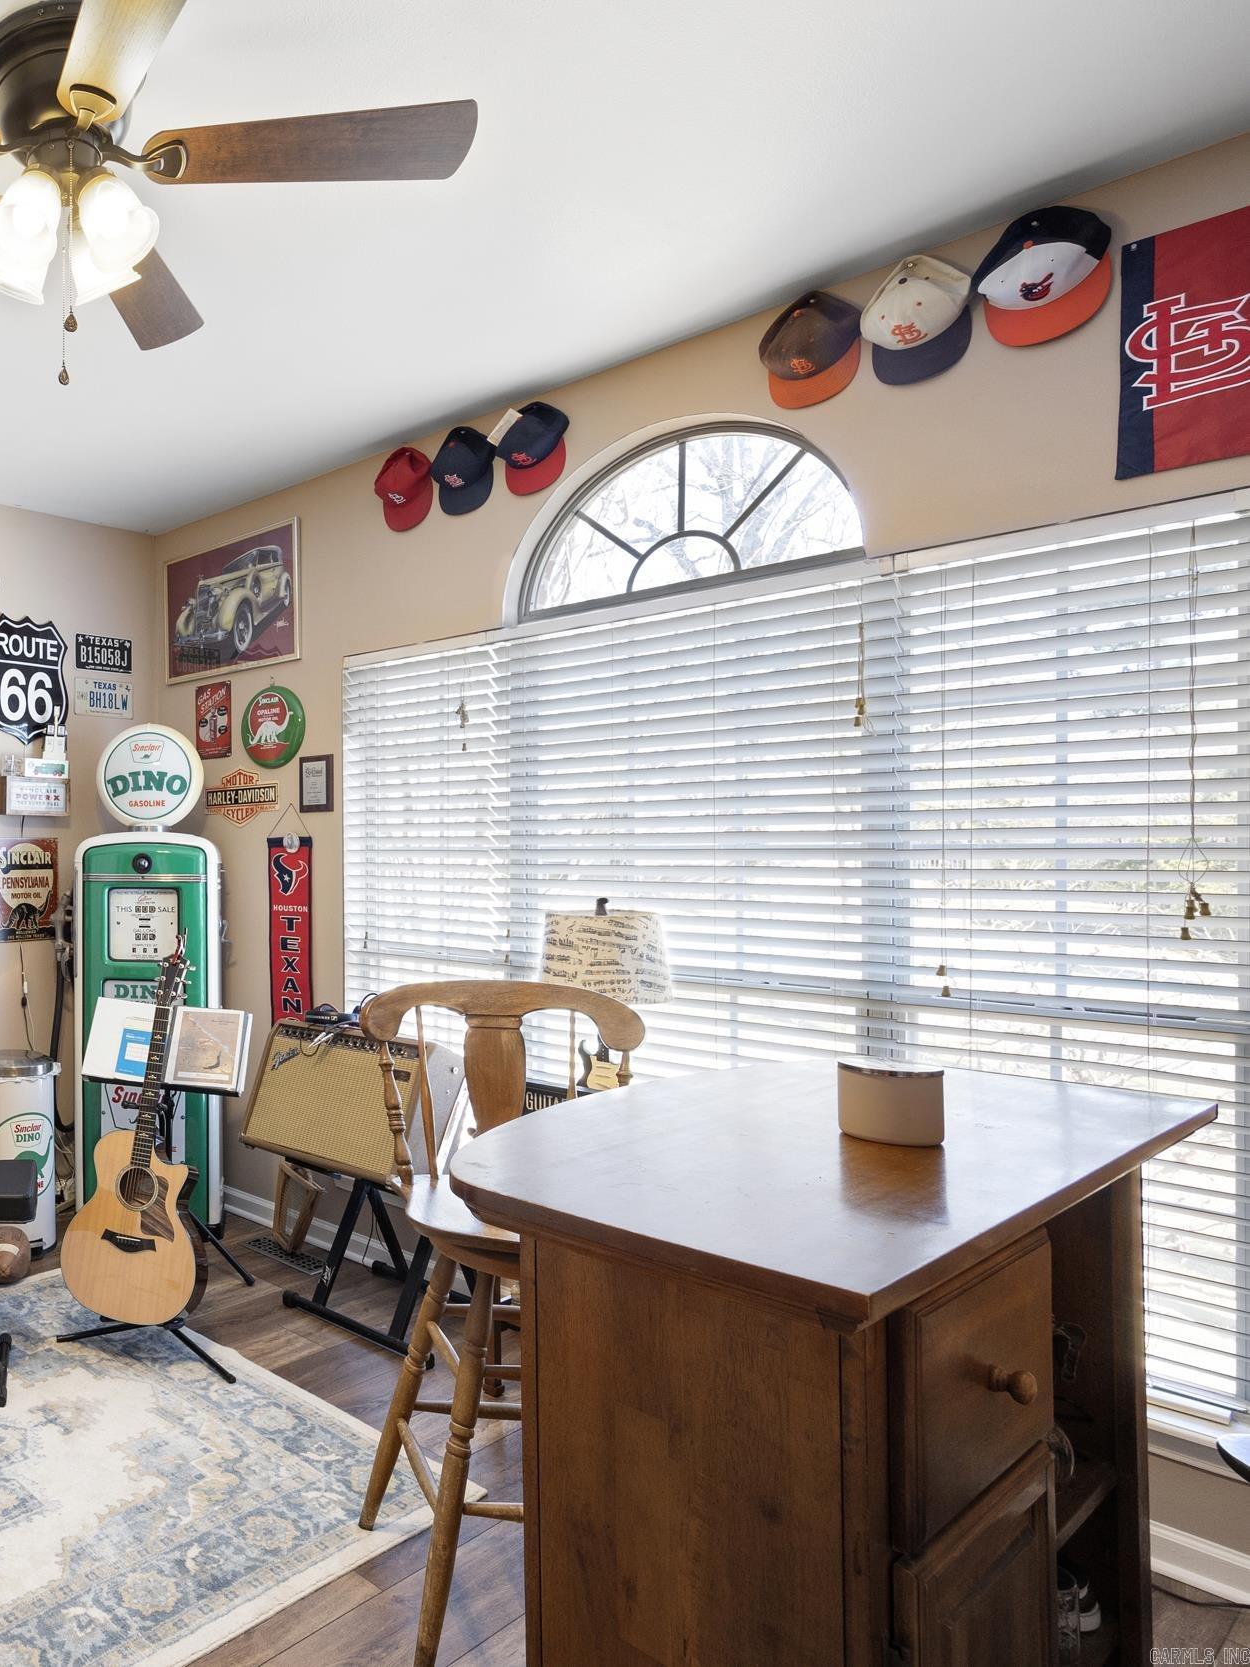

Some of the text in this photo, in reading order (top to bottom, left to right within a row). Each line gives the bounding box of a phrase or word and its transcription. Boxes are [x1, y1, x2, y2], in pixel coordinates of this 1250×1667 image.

[89, 637, 119, 647] TEXAS
[81, 645, 127, 666] B15058J
[94, 682, 117, 690] TEXAS
[0, 669, 52, 724] 66
[198, 689, 211, 705] GAS
[200, 686, 226, 713] STATION
[257, 708, 280, 716] OPALINE
[132, 743, 161, 752] Sinclair
[107, 770, 187, 798] DINO
[225, 771, 254, 786] MOTOR
[207, 786, 276, 806] HARLEY-DAVIDSON
[225, 807, 255, 821] CYCLES
[0, 847, 52, 868] SINCLAIR
[2, 877, 50, 889] PENNSYLVANIA
[279, 915, 303, 1022] TEXAN
[14, 1123, 41, 1133] Sinclair
[16, 1132, 41, 1142] DINO
